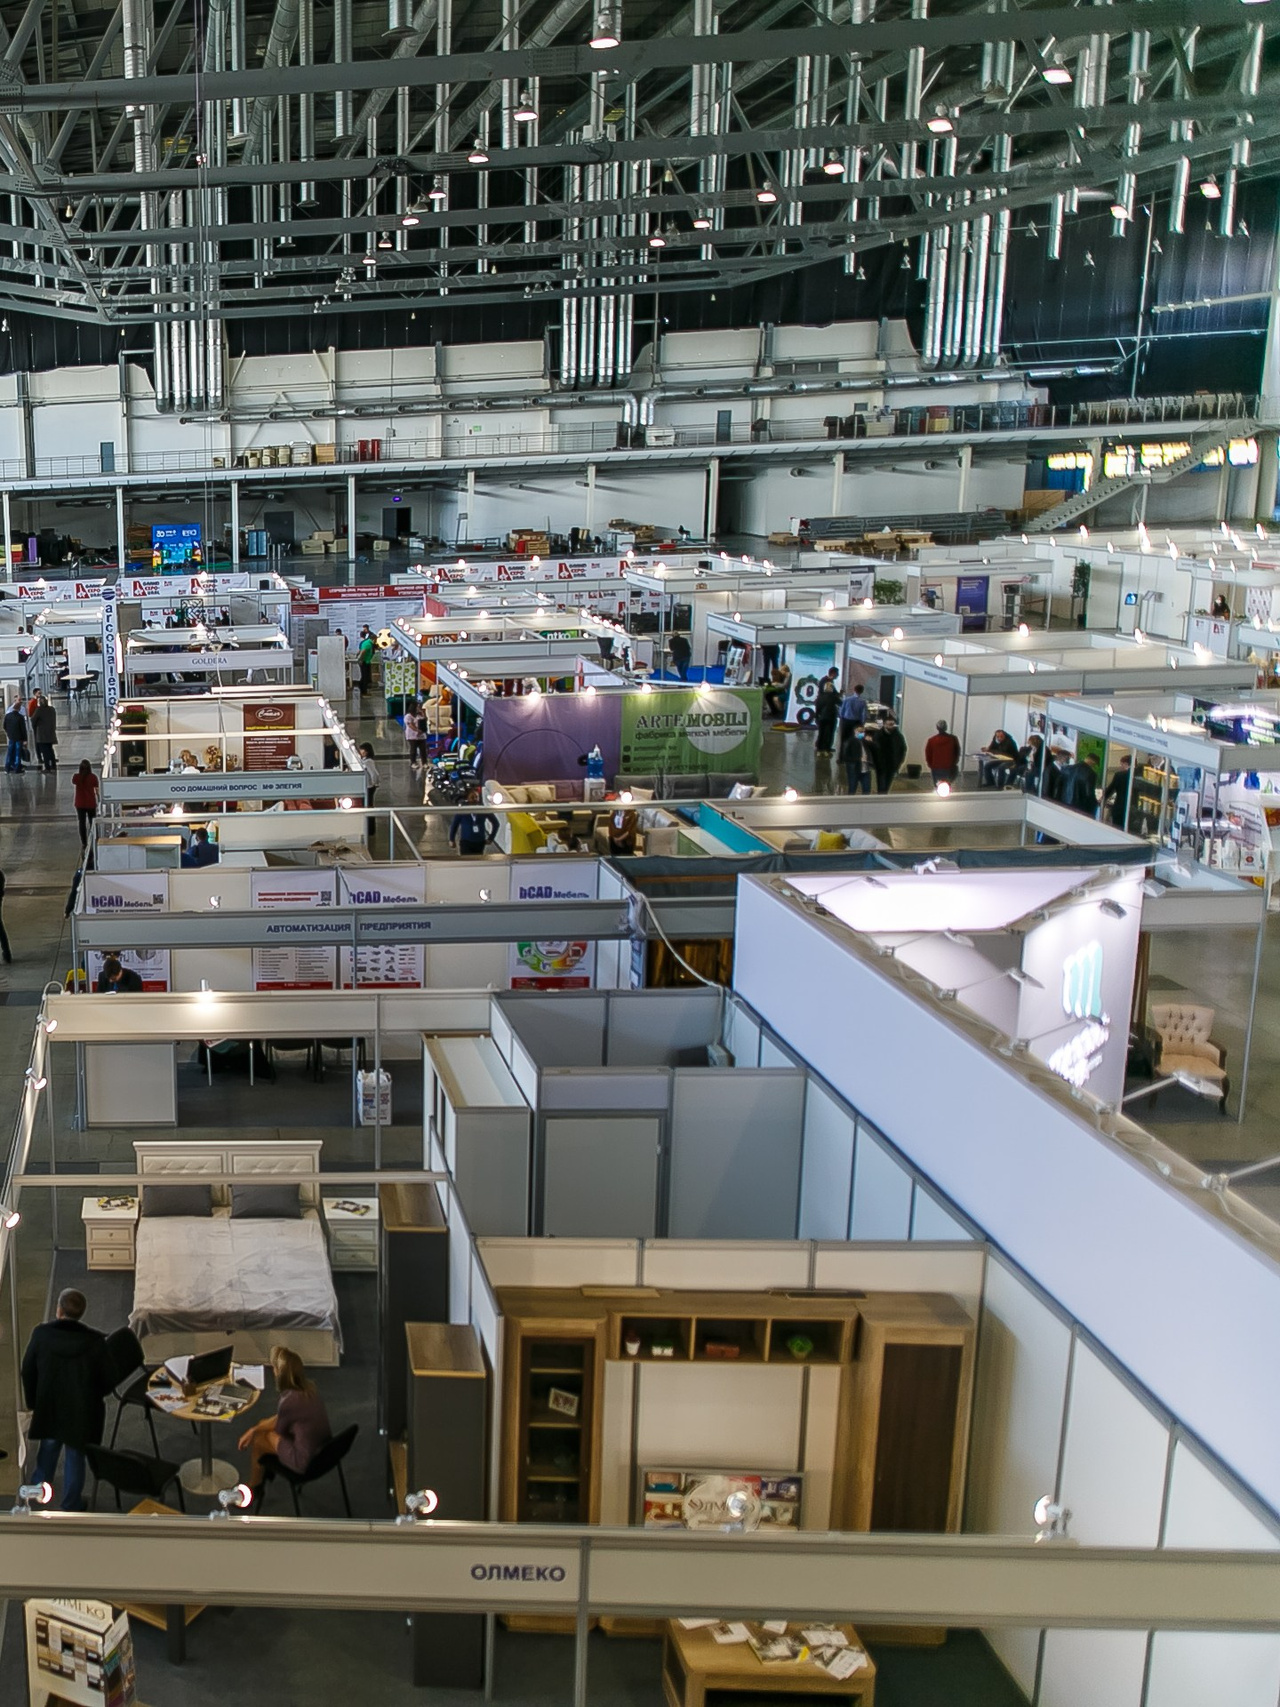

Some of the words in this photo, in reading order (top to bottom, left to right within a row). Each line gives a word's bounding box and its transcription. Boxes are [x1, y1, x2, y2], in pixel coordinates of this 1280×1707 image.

[105, 604, 117, 706] arcobaleno
[191, 657, 228, 665] GOLDERA
[635, 730, 676, 740] фабрика
[678, 729, 710, 738] мягкой
[713, 728, 748, 737] мебели
[187, 784, 228, 792] ДОМАШНИЙ
[519, 886, 553, 899] bCAD
[553, 891, 589, 899] Мебель
[383, 895, 418, 903] Мебель
[126, 901, 157, 909] Мебель
[266, 923, 351, 933] АВТОМАТИЗАЦИЯ
[360, 922, 431, 932] ПРЕДПРИЯТИЯ
[470, 1563, 566, 1582] ОЛМЕКО
